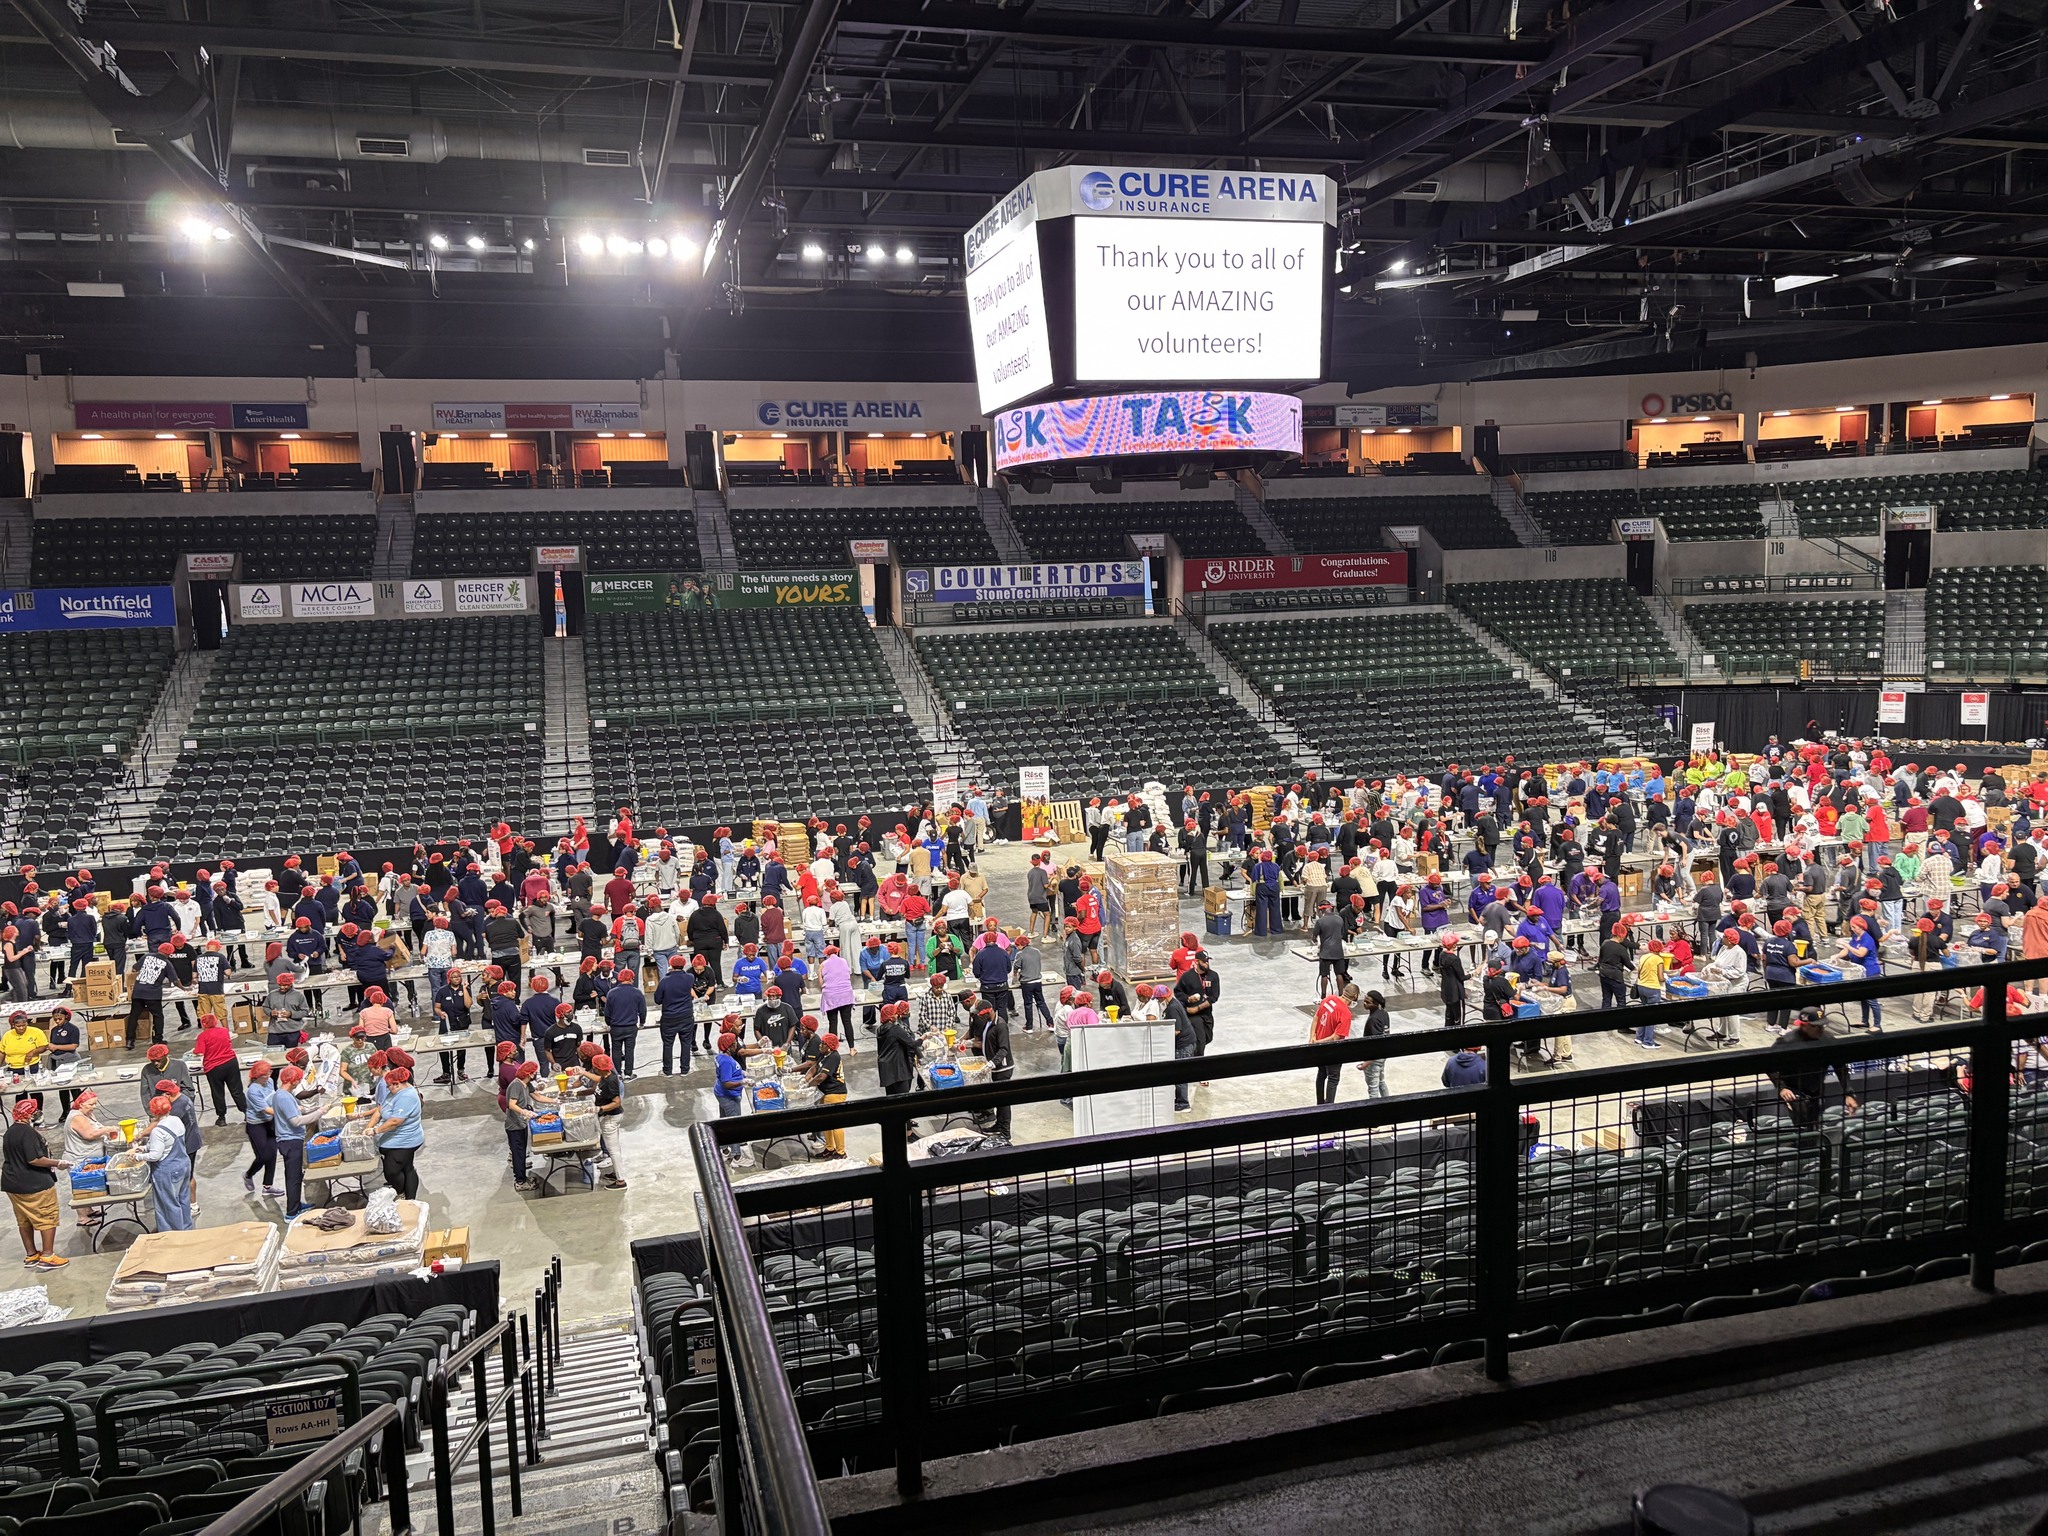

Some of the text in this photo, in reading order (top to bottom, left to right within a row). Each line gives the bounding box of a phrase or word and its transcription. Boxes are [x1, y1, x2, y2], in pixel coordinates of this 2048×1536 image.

[1119, 172, 1318, 202] CURE ARENA
[1119, 200, 1210, 213] INSURANCE
[975, 183, 1034, 249] CURE ARENA
[1097, 244, 1305, 274] Thank you to all of
[974, 254, 1034, 315] Thank you to all of
[1127, 290, 1274, 311] our AMAZING
[986, 305, 1030, 348] our AMAZING
[1138, 331, 1262, 354] volunteers!
[993, 347, 1031, 384] volunteers!
[786, 402, 922, 418] CURE ARENA
[1388, 405, 1420, 413] CRUISING
[1671, 393, 1732, 413] PSEG
[100, 410, 131, 418] health
[132, 410, 153, 420] plan
[156, 410, 170, 418] for
[172, 411, 217, 420] everyone.
[243, 415, 296, 423] AmeriHealth
[436, 409, 502, 419] RWJBarnabas
[528, 412, 546, 420] healthy
[575, 409, 639, 418] RWJBarnabas
[1122, 391, 1254, 437] TASK
[786, 419, 849, 427] INSURANCE
[995, 408, 1047, 454] ASK
[1022, 451, 1049, 461] Kitchen
[854, 542, 885, 550] Chambers
[1771, 542, 1785, 555] 118
[193, 555, 228, 563] CASE'S
[1320, 557, 1390, 568] Congratulations,
[1545, 550, 1557, 562] 118
[1228, 559, 1276, 572] RIDER
[1291, 557, 1304, 572] 117
[741, 575, 759, 583] The
[761, 574, 790, 583] future
[791, 574, 820, 583] needs
[830, 574, 853, 583] story
[1019, 567, 1032, 581] 116
[1228, 572, 1276, 580] UNIVERSITY
[1332, 568, 1378, 580] Graduates!
[458, 583, 504, 593] MERCER
[605, 580, 653, 590] MERCER
[718, 574, 733, 590] 115
[301, 584, 361, 602] MCIA
[379, 583, 395, 599] 114
[741, 585, 769, 594] to tell
[775, 583, 851, 605] YOURS.
[975, 585, 1108, 601] StoneTechMarble.com
[16, 593, 34, 609] 113
[59, 594, 152, 612] Northfield
[458, 594, 503, 603] COUNTY
[127, 610, 152, 619] Bank
[242, 608, 282, 616] RECYCLES
[271, 1398, 329, 1416] SECTION 107
[275, 1418, 331, 1435] Rows AA-HH
[615, 1481, 637, 1495] A
[613, 1517, 636, 1534] B
